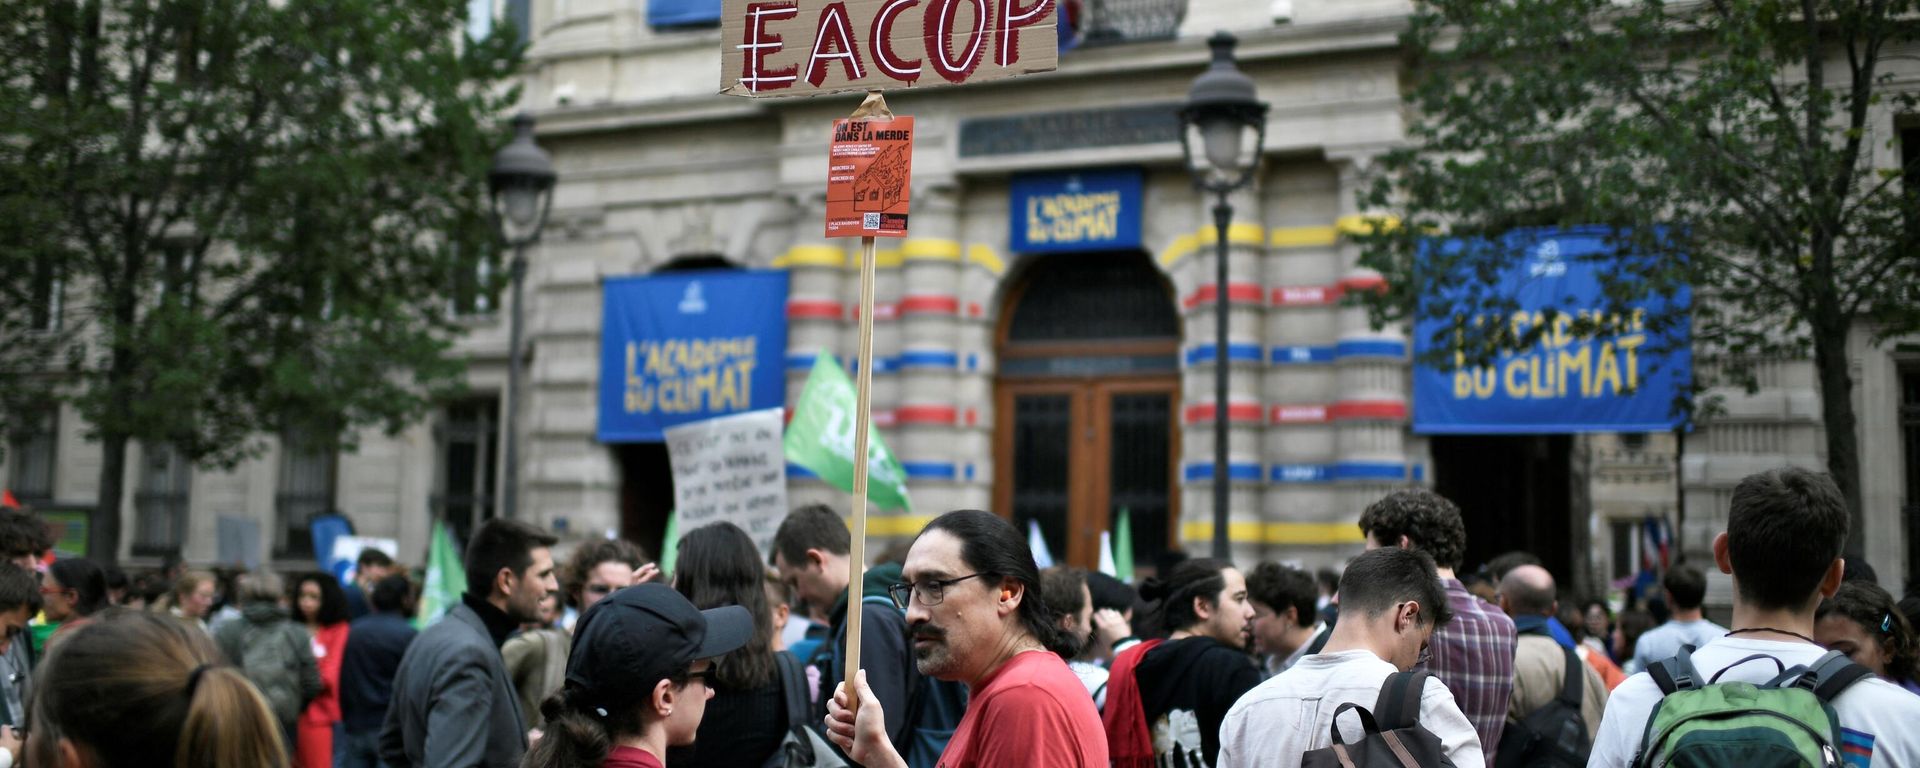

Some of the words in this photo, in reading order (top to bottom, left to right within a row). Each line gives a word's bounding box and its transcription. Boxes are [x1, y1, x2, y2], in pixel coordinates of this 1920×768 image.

[737, 0, 1058, 92] EACOP
[835, 131, 859, 142] DANS
[862, 131, 873, 141] LA
[876, 130, 910, 141] MERDE
[836, 122, 848, 132] ON
[851, 121, 868, 132] EST
[1455, 365, 1496, 398] DU
